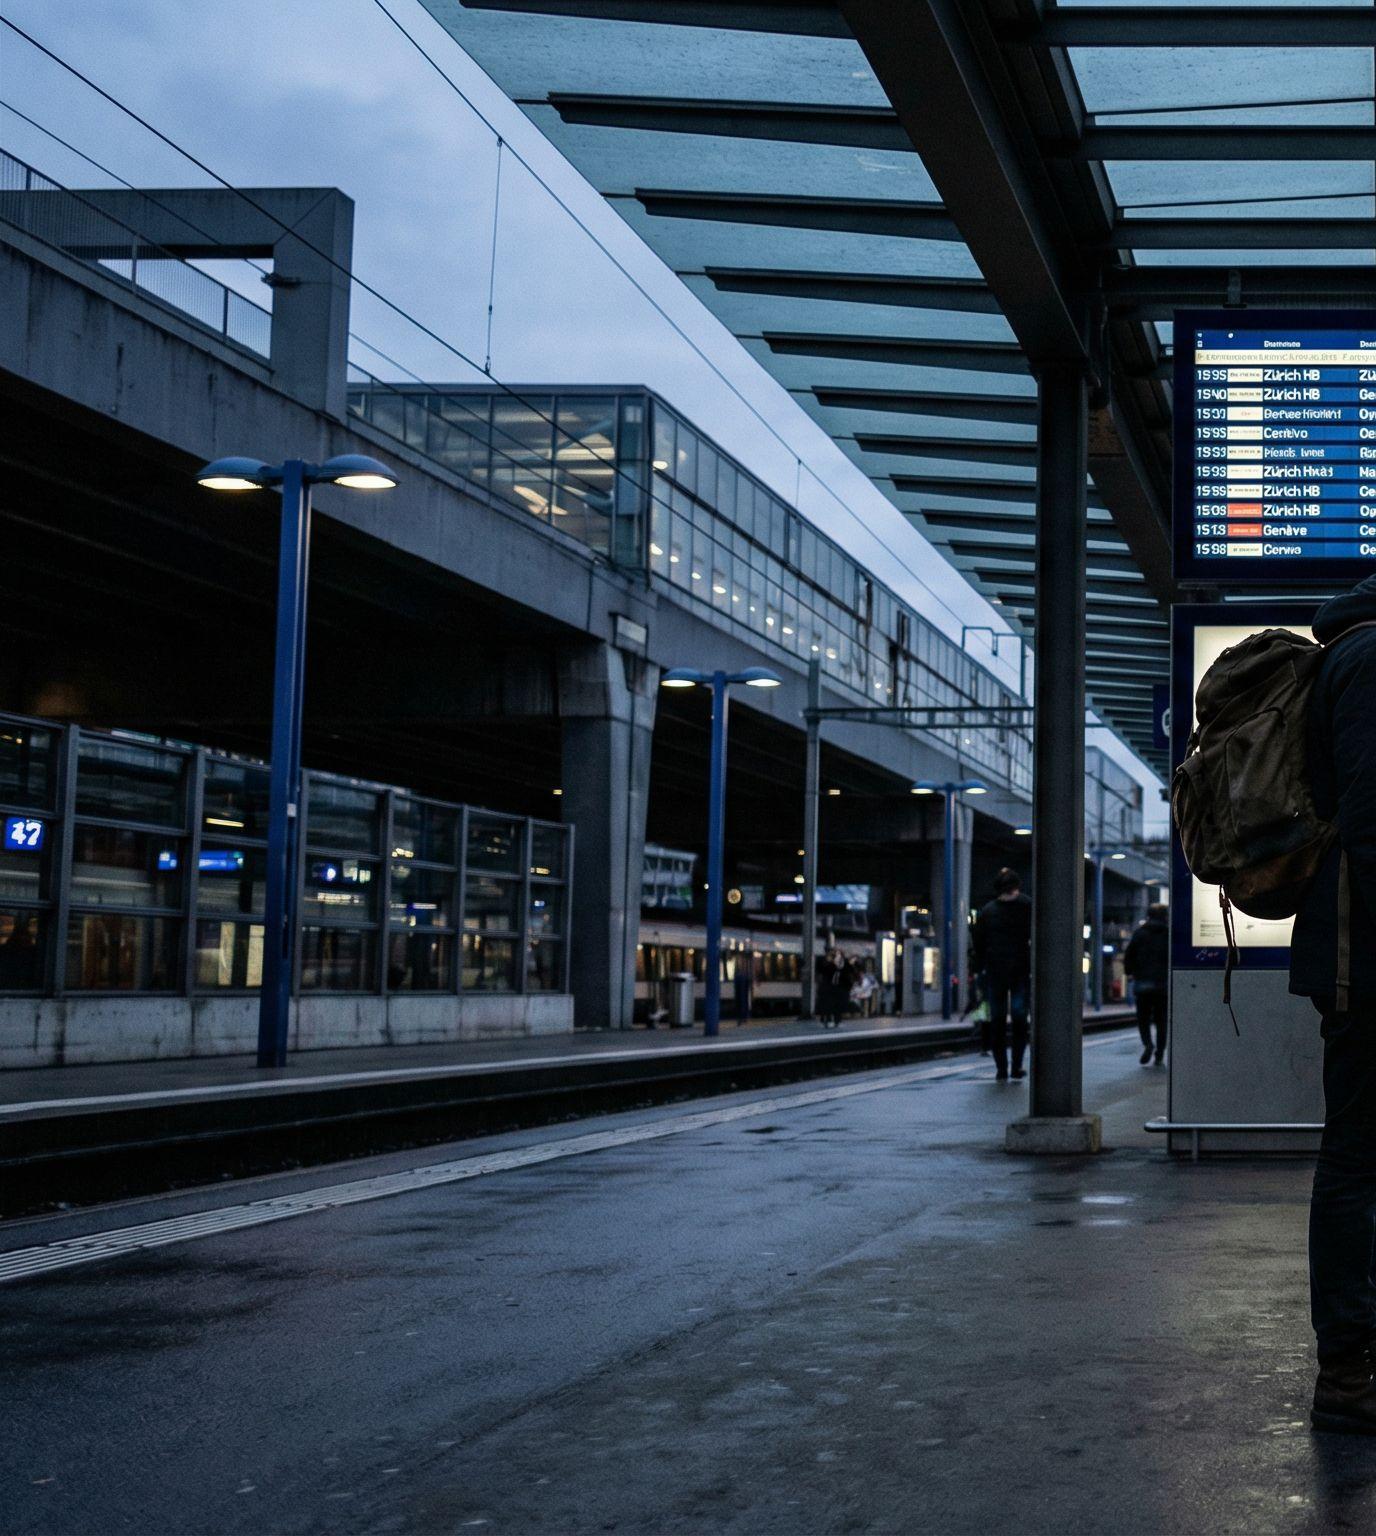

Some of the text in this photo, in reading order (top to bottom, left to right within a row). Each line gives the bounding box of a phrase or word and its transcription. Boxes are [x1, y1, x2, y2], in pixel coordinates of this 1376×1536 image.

[1304, 370, 1320, 380] HB
[1303, 388, 1320, 400] HB
[1303, 485, 1320, 496] HB
[1303, 504, 1320, 516] HB
